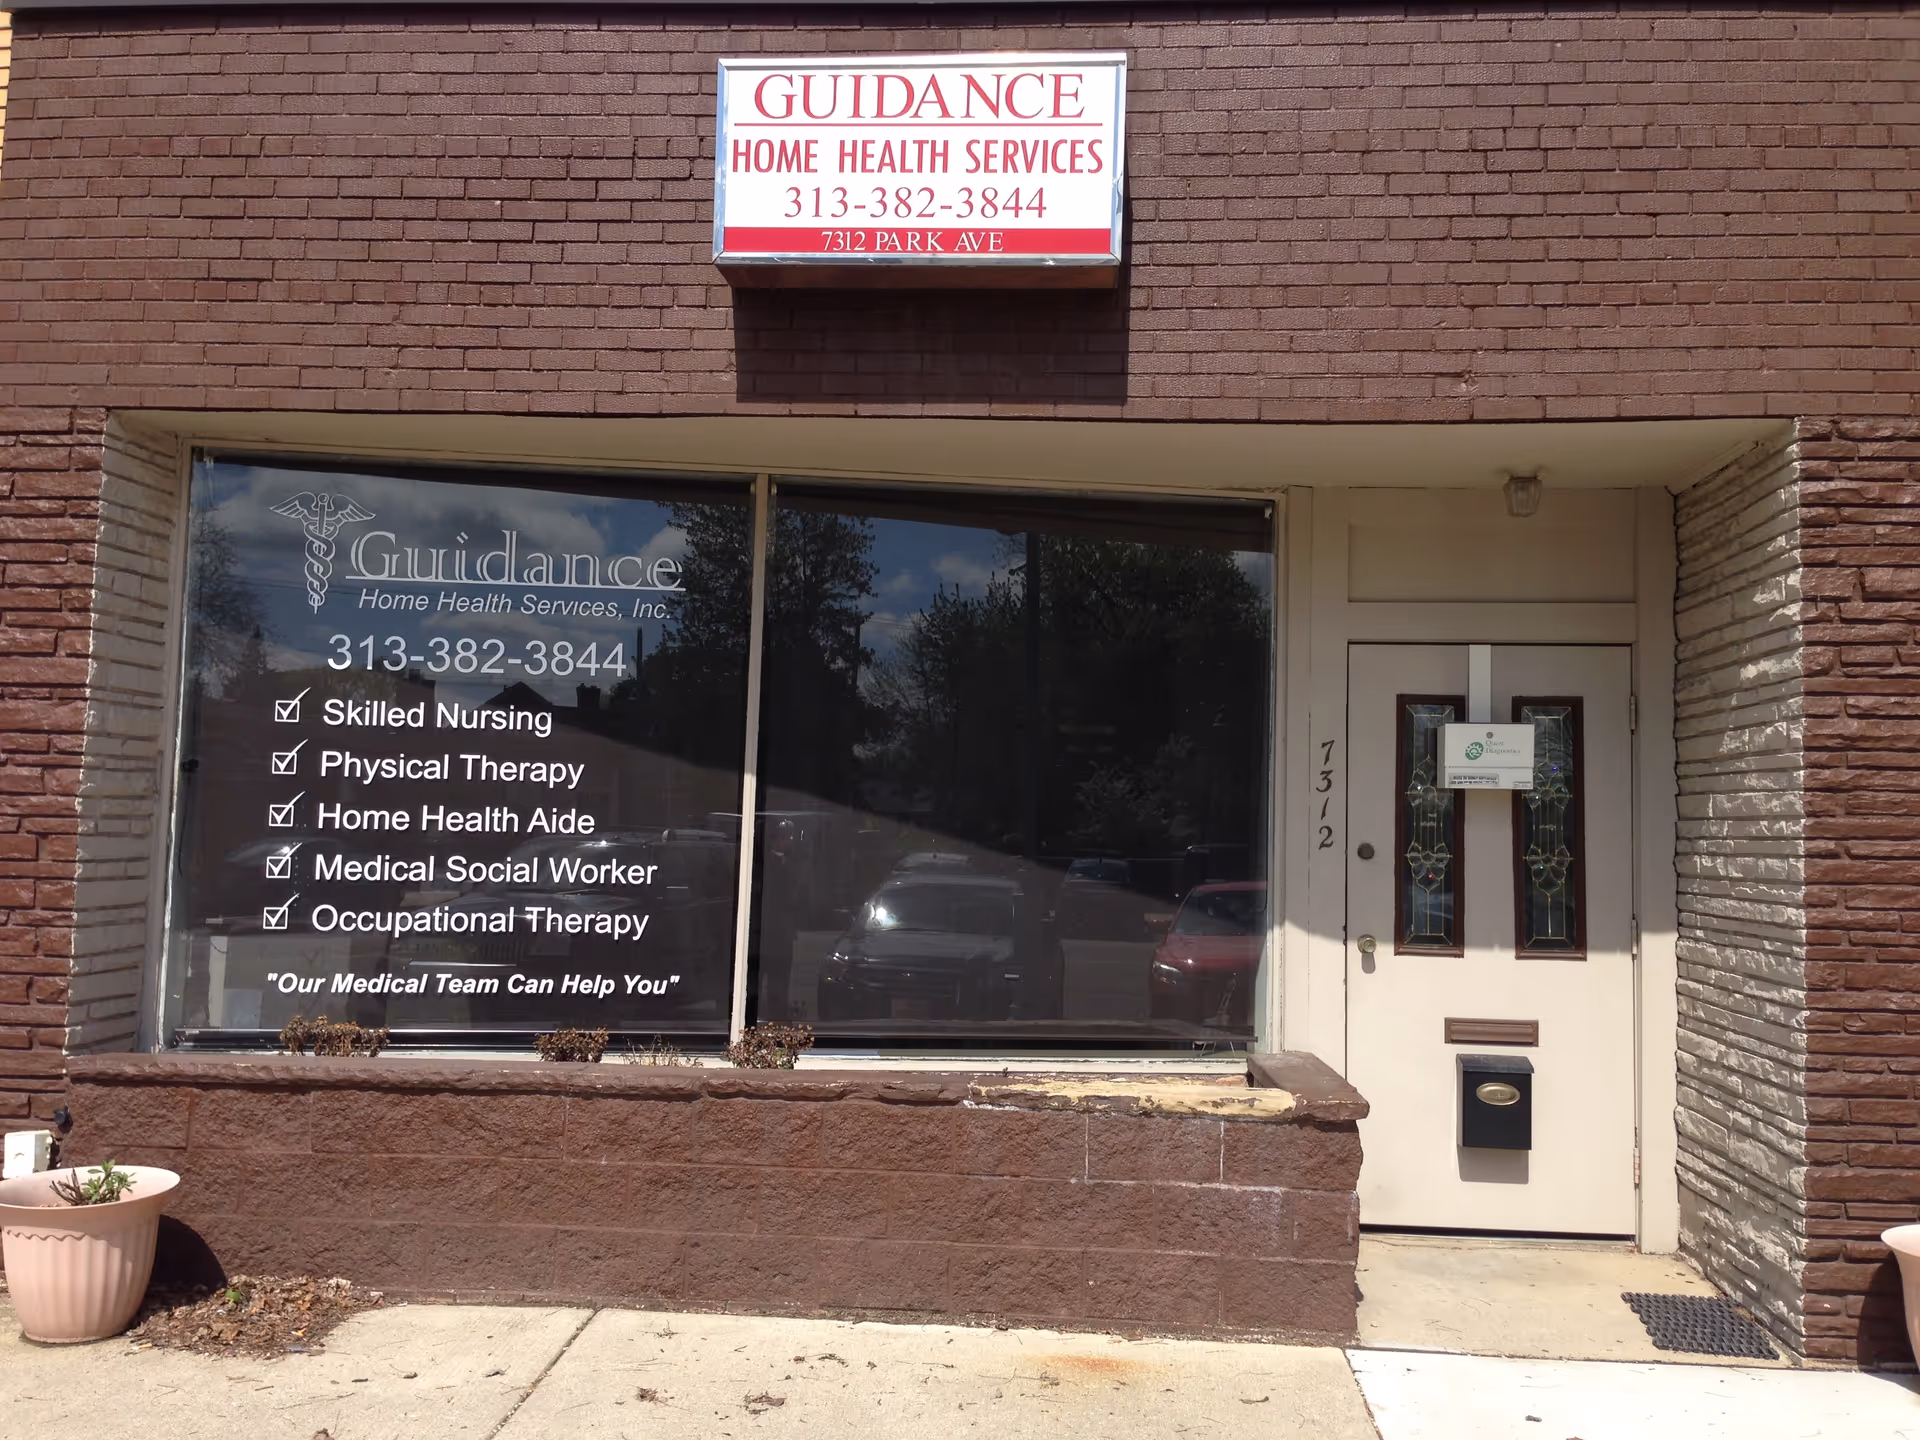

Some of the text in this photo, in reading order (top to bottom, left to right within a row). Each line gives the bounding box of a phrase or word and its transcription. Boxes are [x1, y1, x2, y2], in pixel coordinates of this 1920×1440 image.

[754, 73, 1085, 119] GUIDANCE
[732, 139, 1103, 174] HOME HEALTH SERVICES
[784, 186, 1047, 218] 313-382-3844
[821, 231, 1004, 252] 7312 PARK AVE
[350, 529, 683, 589] Guidance
[358, 589, 672, 621] Home Health Services, Inc.
[327, 634, 627, 677] 313-382-3844
[322, 699, 552, 737] Skilled Nursing
[321, 751, 584, 789] Physical Therapy
[1315, 740, 1335, 850] 7312
[317, 803, 595, 834] Home Health Aide
[314, 854, 658, 885] Medical Social Worker
[312, 904, 649, 940] Occupational Therapy
[267, 972, 680, 999] "Our Medical Team Can Help You"
